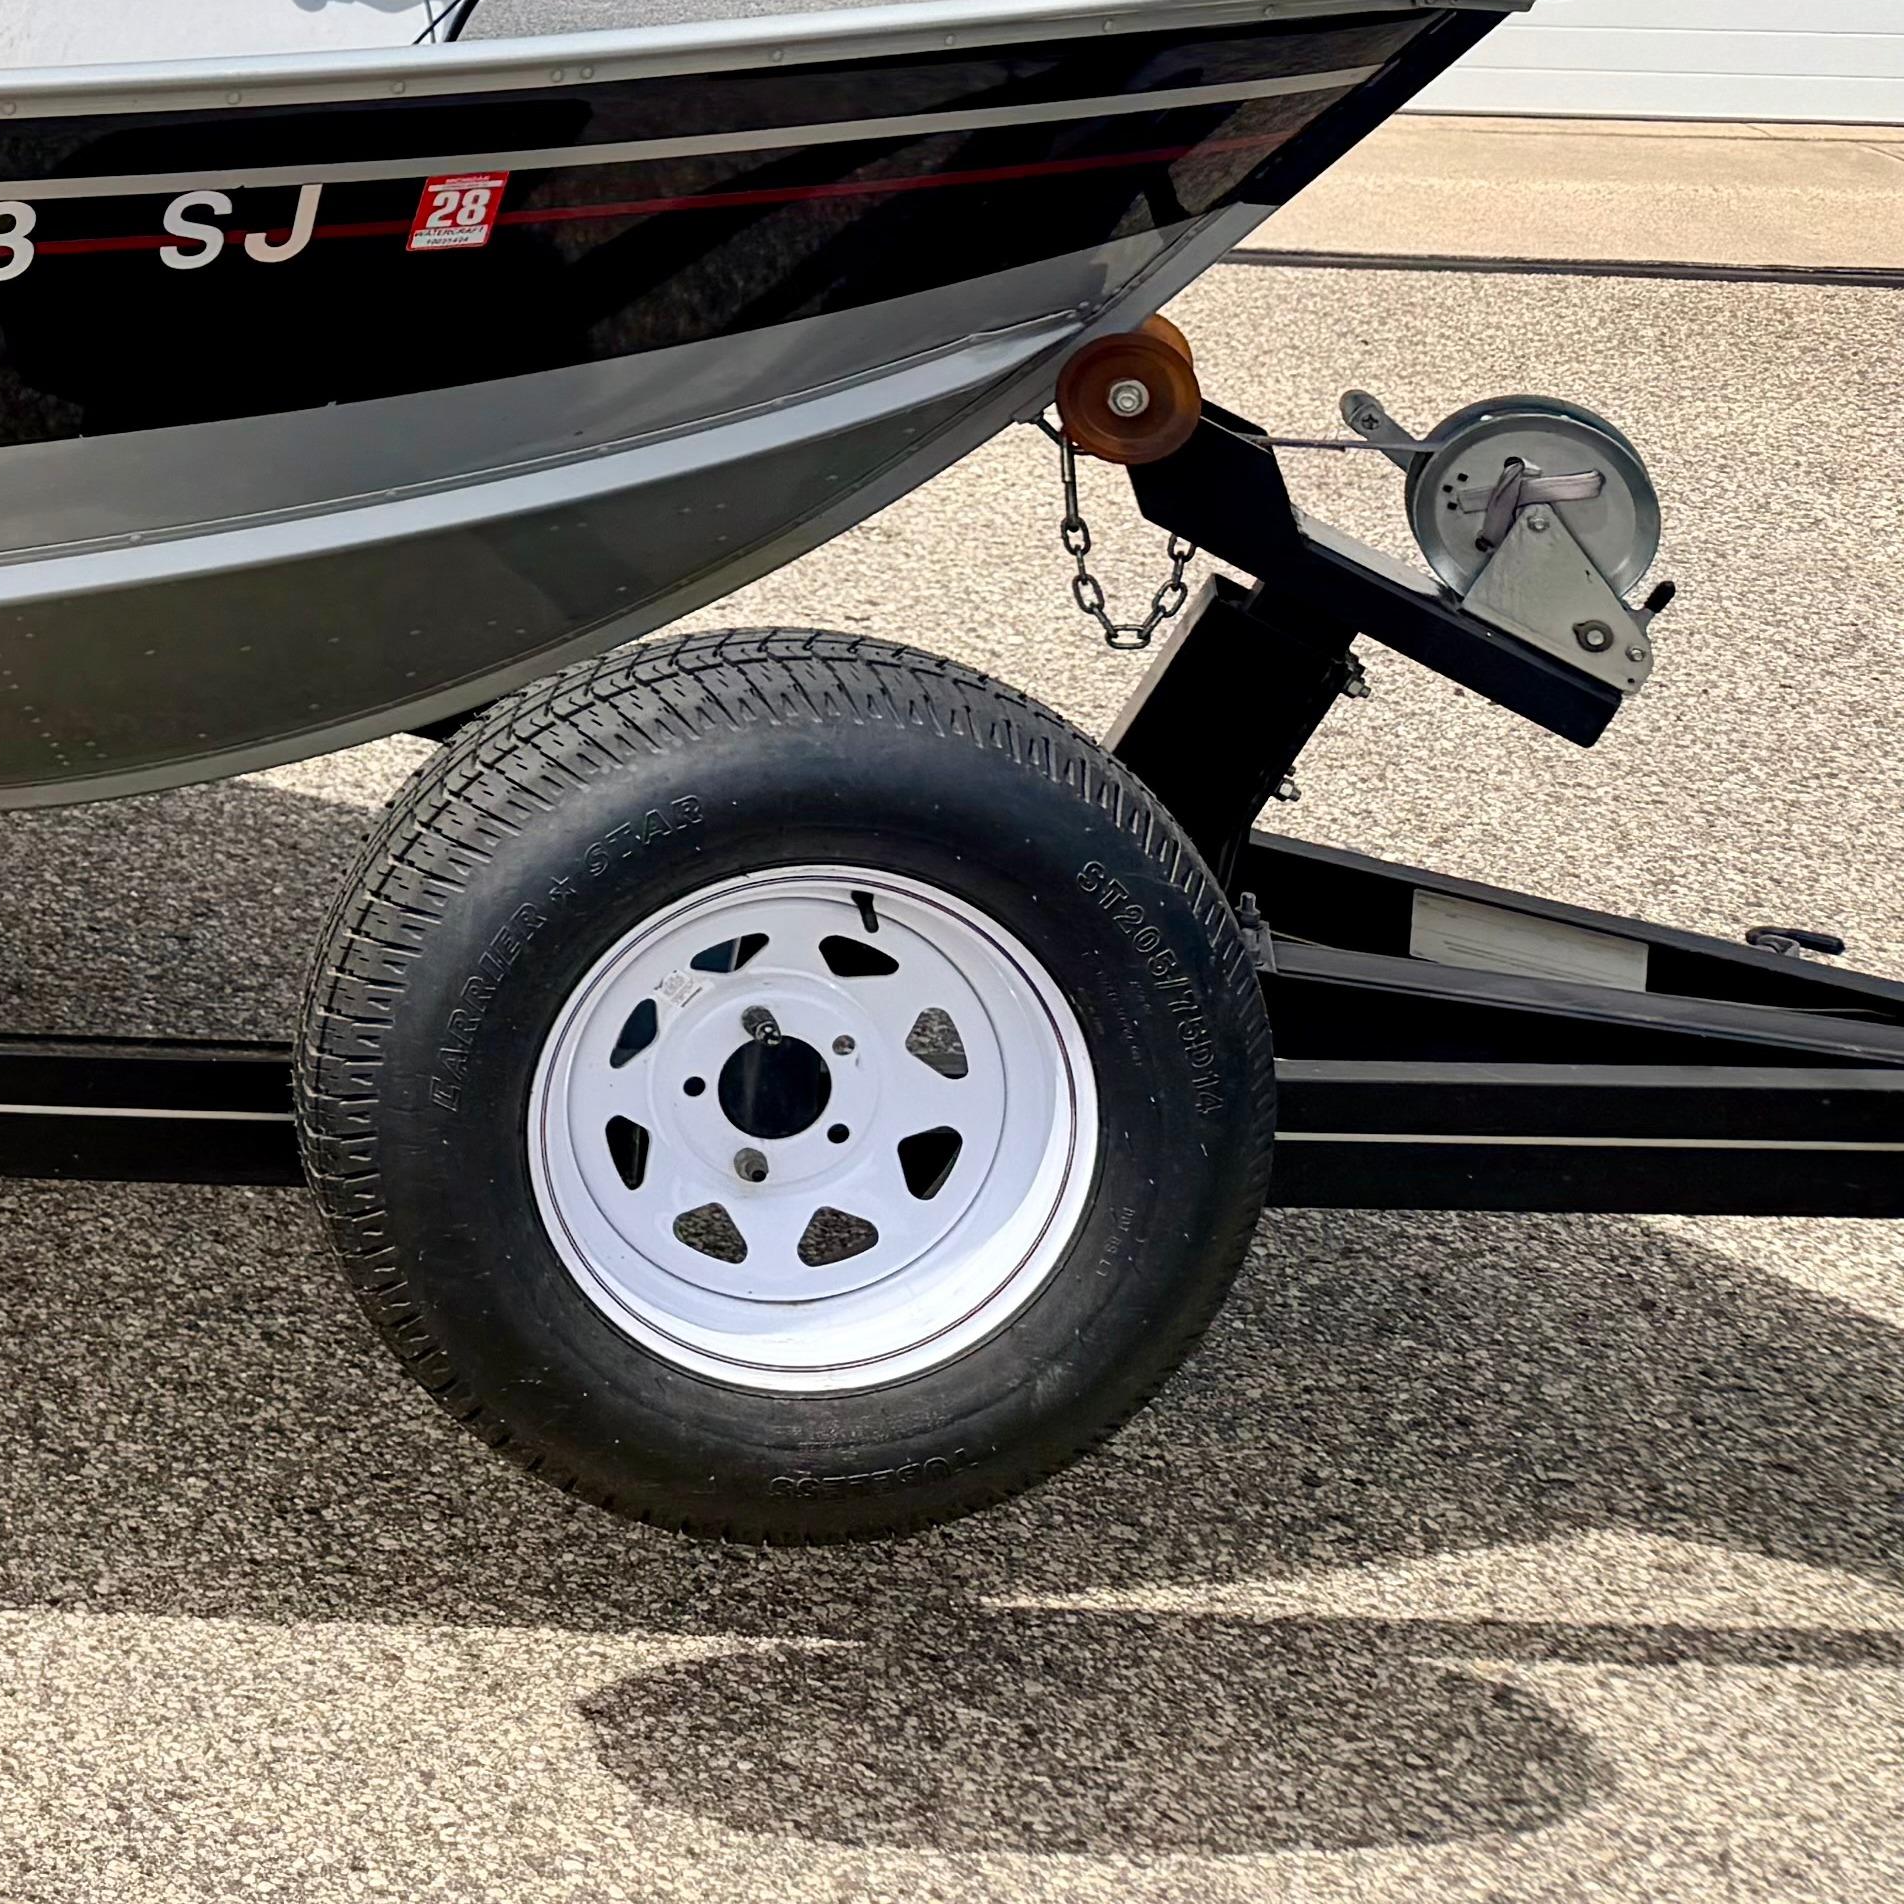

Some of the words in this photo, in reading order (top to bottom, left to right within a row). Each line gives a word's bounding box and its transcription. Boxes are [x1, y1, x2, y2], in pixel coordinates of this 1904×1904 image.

[159, 183, 323, 271] SJ
[425, 188, 492, 229] 28
[583, 794, 704, 877] STAR
[1075, 860, 1225, 1115] ST205/75D14
